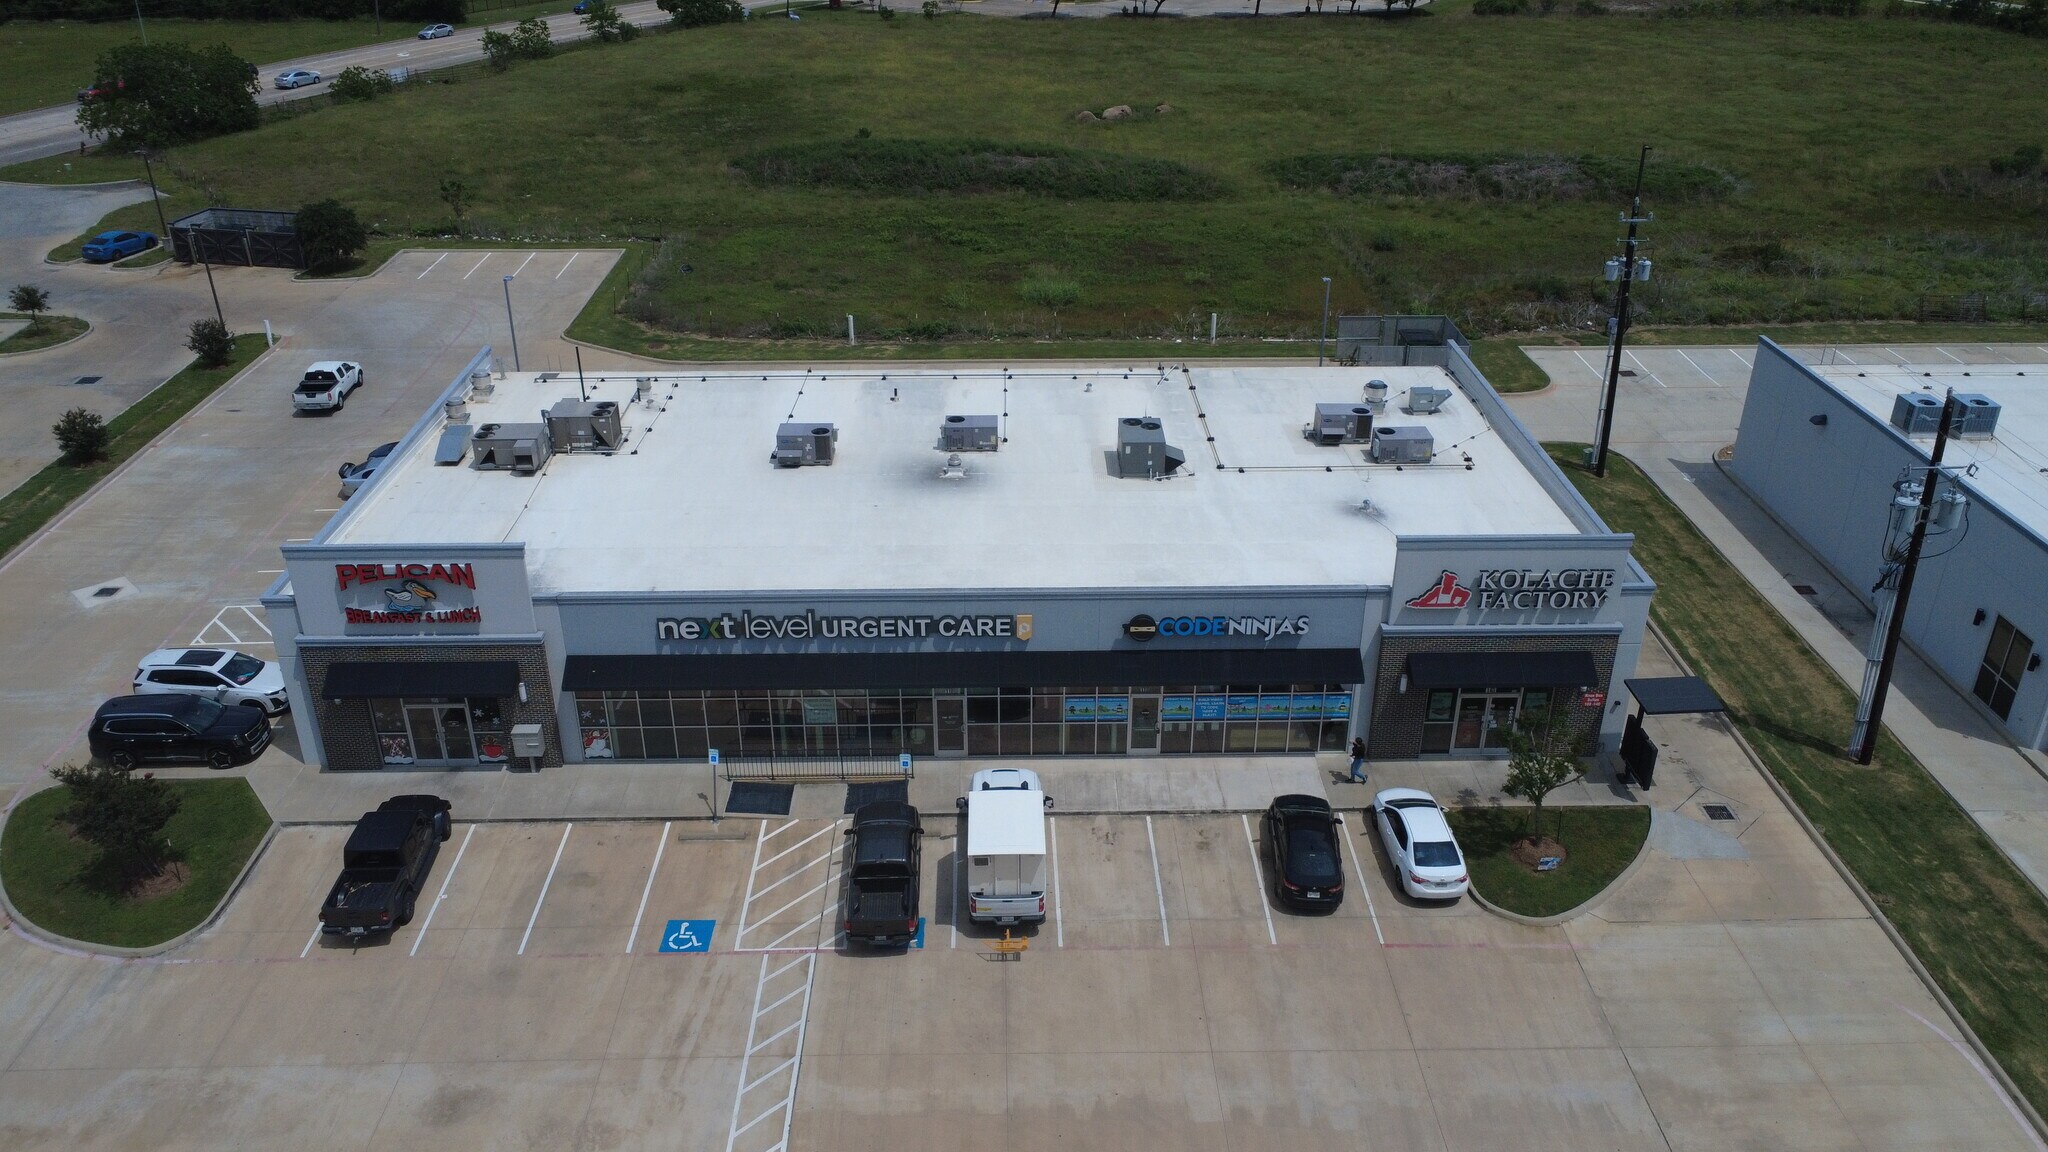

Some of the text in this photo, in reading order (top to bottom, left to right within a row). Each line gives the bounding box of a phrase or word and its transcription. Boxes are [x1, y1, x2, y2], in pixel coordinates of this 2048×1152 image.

[335, 563, 476, 591] PELICAN
[1479, 569, 1616, 589] KOLACHE
[1479, 589, 1609, 609] FACTORY
[345, 606, 481, 624] BREAKFAST & LUNCH
[657, 610, 1012, 640] next level URGENT CARE
[1158, 615, 1310, 641] CODE NINJAS
